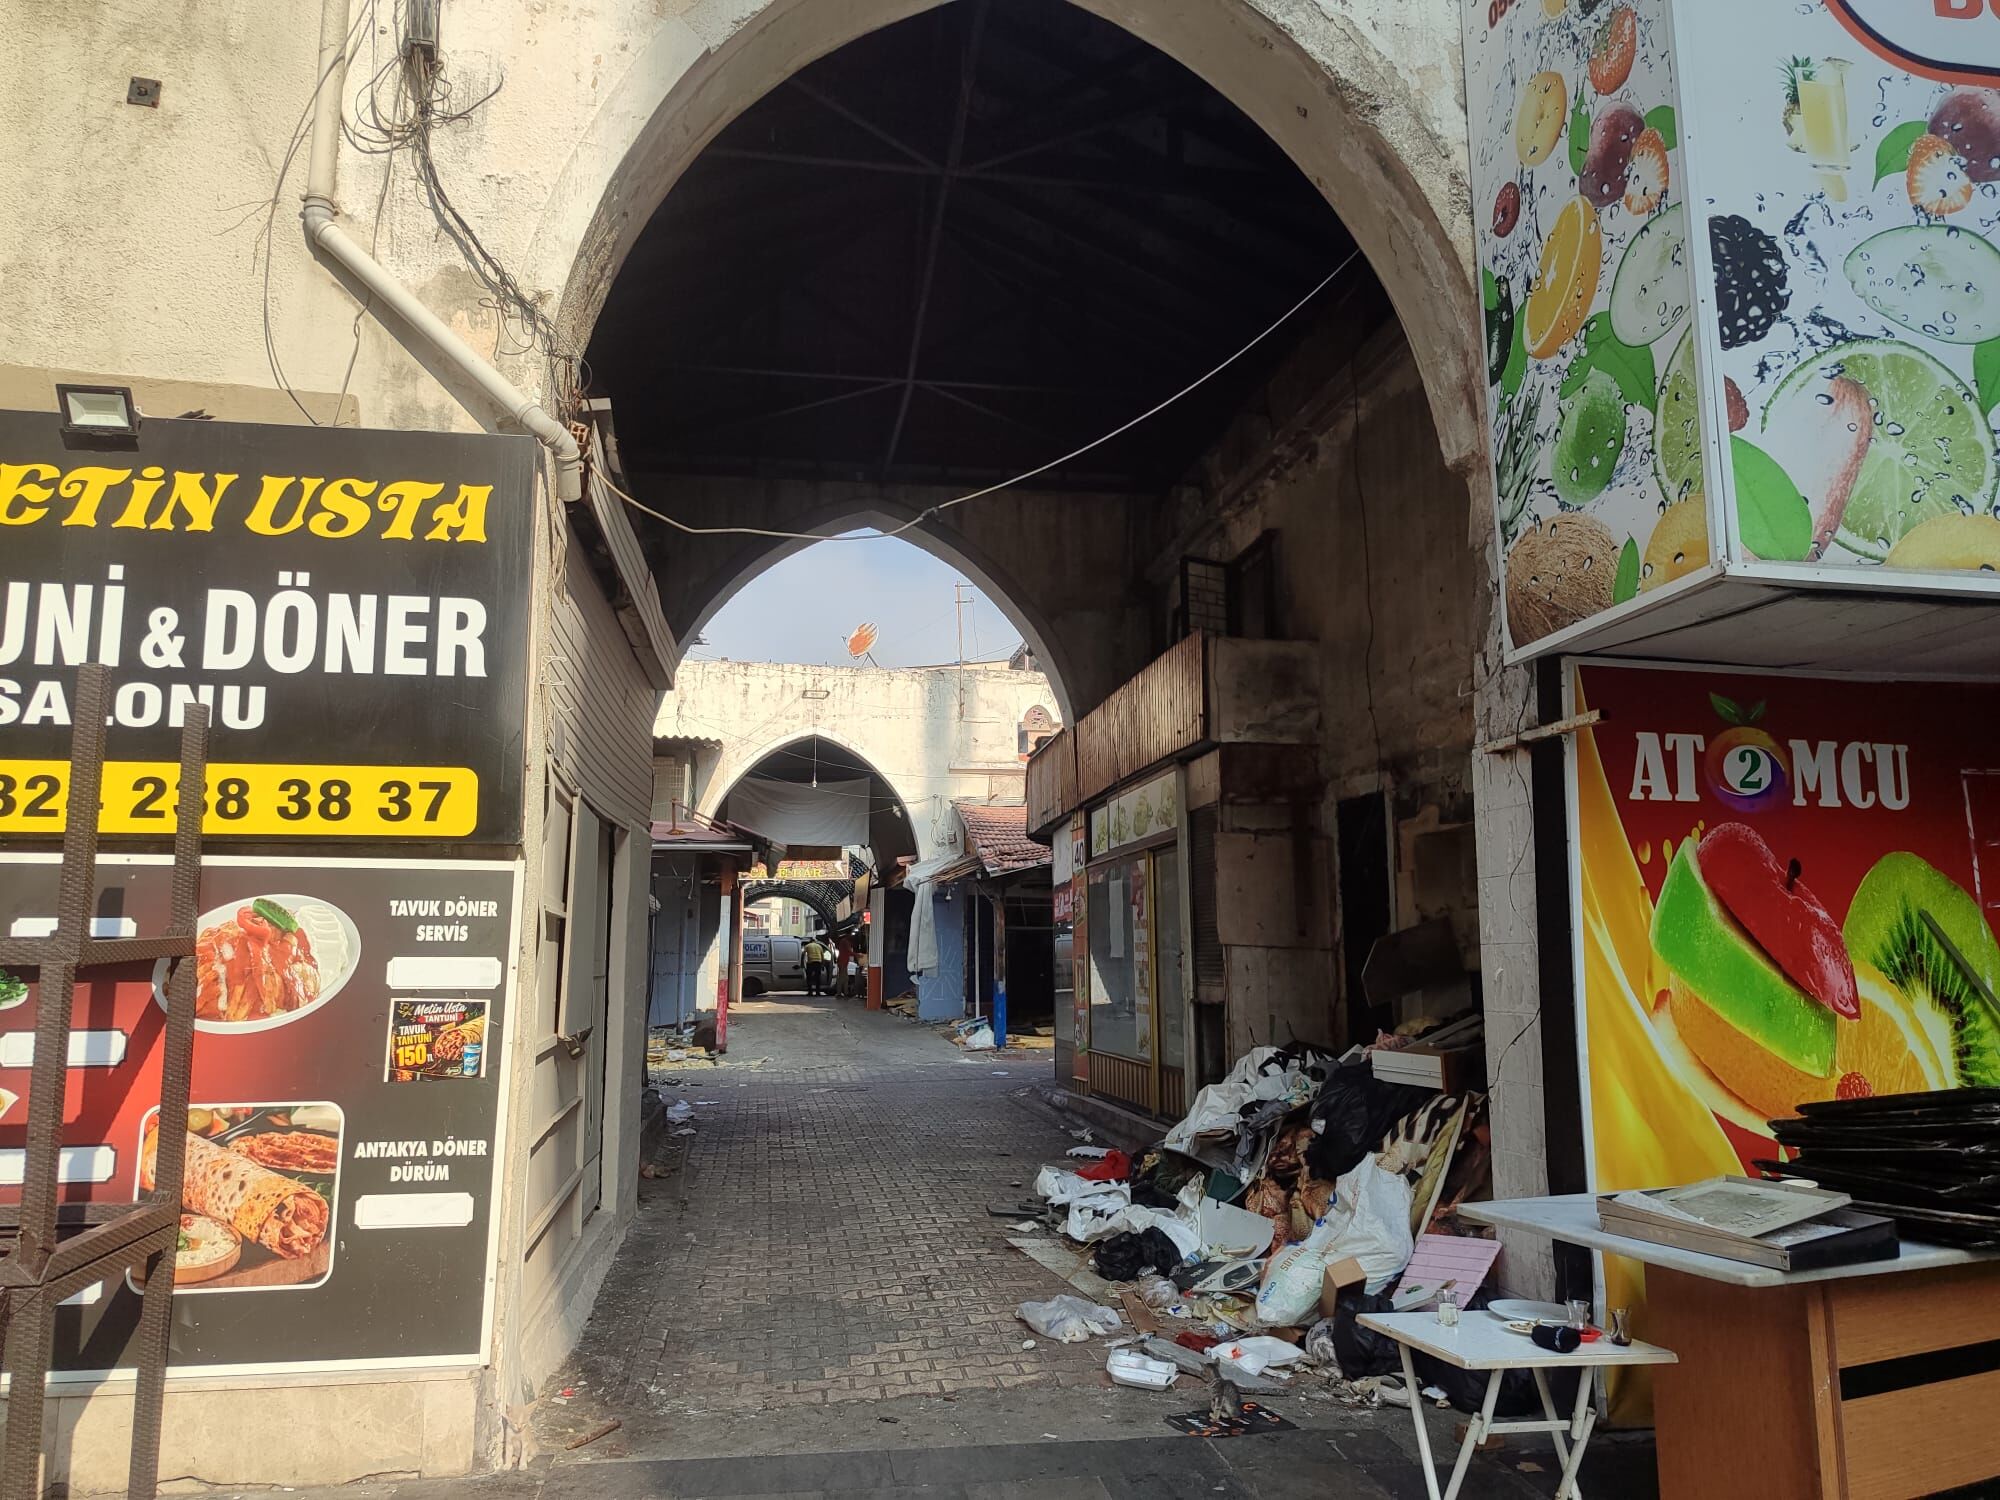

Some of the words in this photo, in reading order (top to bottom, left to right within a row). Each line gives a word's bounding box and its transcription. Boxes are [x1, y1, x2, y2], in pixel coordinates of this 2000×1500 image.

[245, 476, 494, 543] USTA
[140, 607, 186, 668] &
[202, 571, 488, 677] DÖNER
[276, 778, 352, 822] 38
[378, 780, 452, 822] 37
[390, 900, 440, 917] TAVUK
[444, 896, 498, 917] DÖNER
[416, 920, 469, 941] SERVİS
[414, 1004, 443, 1016] Metin
[444, 1003, 467, 1013] Usta
[399, 1025, 426, 1036] TAVUK
[396, 1044, 426, 1066] 150
[354, 1141, 428, 1158] ANTAKYA
[432, 1136, 487, 1157] DÖNER
[390, 1161, 449, 1182] DÜRÜM
